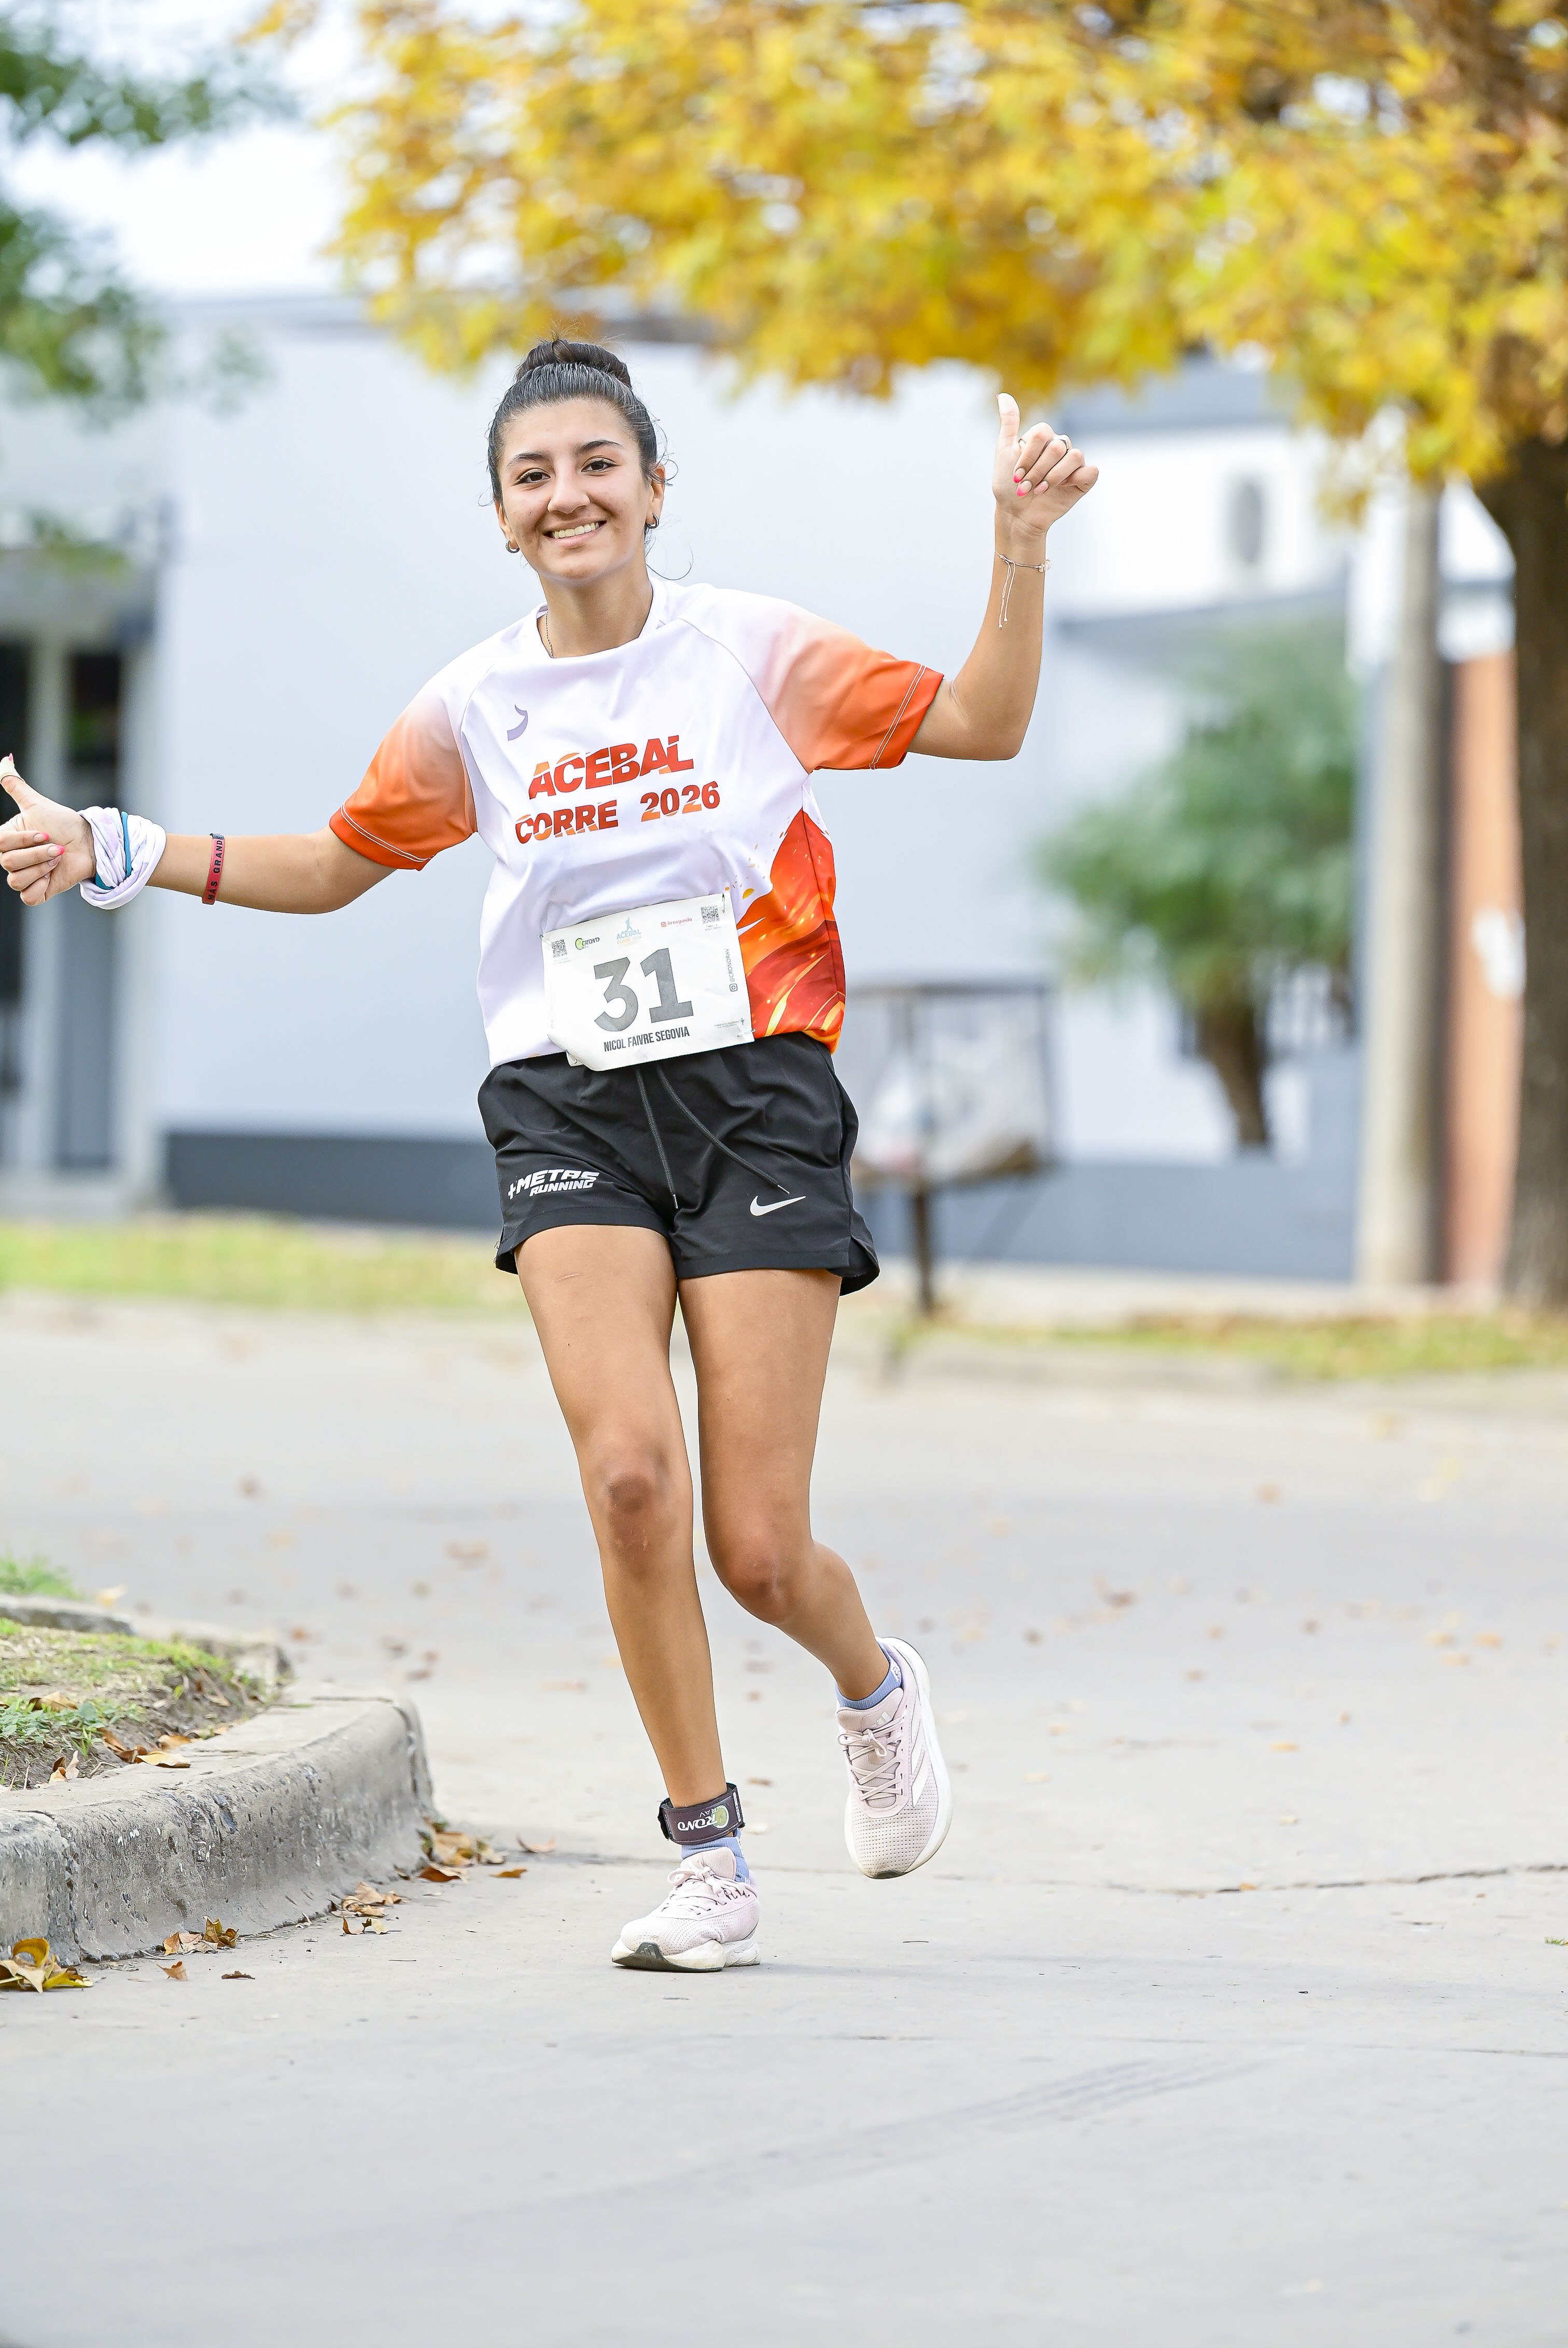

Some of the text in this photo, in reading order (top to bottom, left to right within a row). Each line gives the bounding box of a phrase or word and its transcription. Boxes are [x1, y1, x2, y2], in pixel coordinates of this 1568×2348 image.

[528, 735, 694, 800] ACEBAL
[515, 781, 720, 844] CORRE 2026
[594, 948, 693, 1031] 31
[604, 1026, 690, 1052] NICOL FAIVRE SEGOVIA
[529, 1180, 594, 1197] RUNNING
